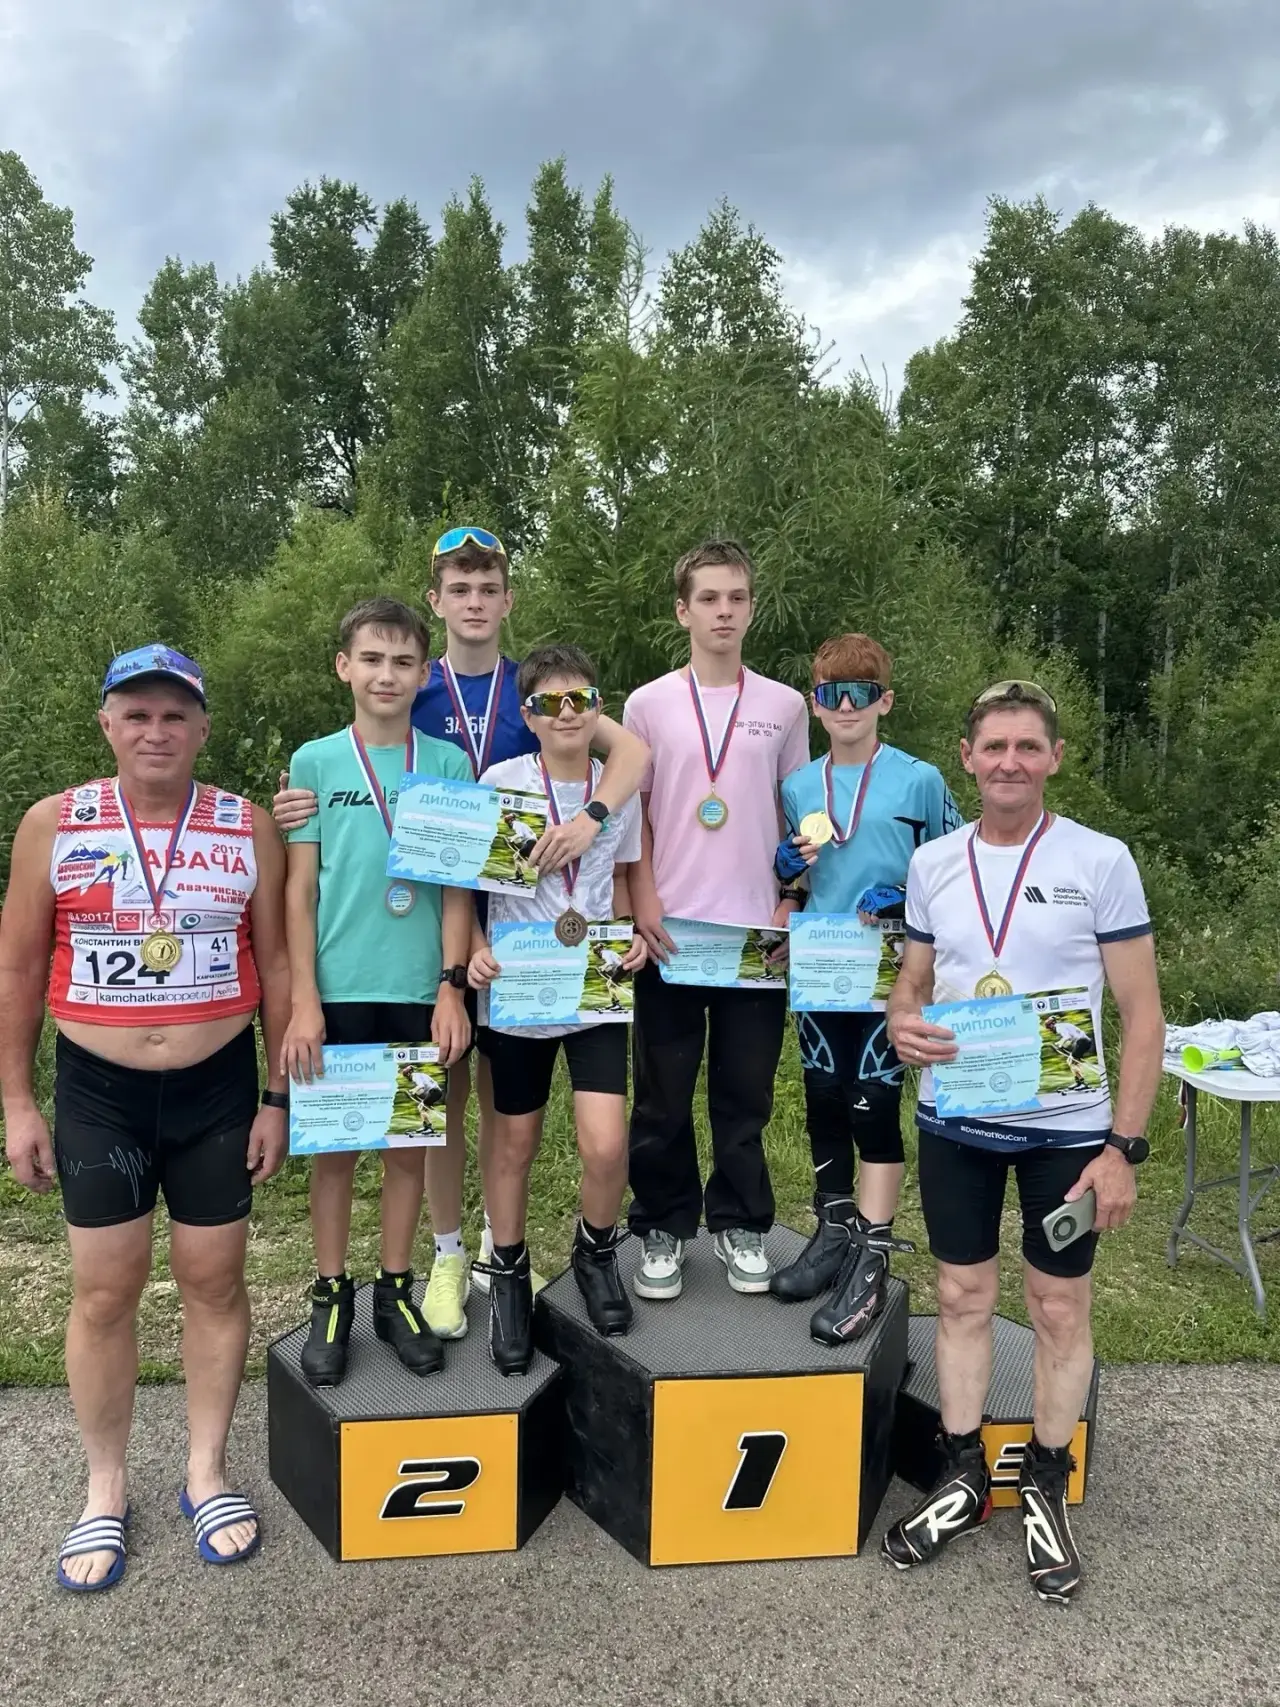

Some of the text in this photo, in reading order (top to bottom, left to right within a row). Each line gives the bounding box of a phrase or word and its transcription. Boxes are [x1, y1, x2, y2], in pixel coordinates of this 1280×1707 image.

[328, 790, 375, 808] FILA
[419, 793, 481, 811] ДИПЛОМ
[212, 844, 242, 855] 2017
[145, 849, 249, 876] АВАЧА
[1053, 886, 1079, 894] Galaxy
[75, 937, 131, 946] КОНСТАНТИН
[808, 929, 864, 940] ДИПЛОМ
[211, 936, 228, 952] 41
[513, 939, 566, 951] ДИПЛО
[86, 951, 170, 985] 124
[100, 991, 210, 1003] kamchatkaloppet.ru
[951, 1014, 1017, 1034] ДИПЛОМ
[323, 1061, 376, 1075] ИПЛОМ
[960, 1125, 1028, 1142] #DoWhatYouCant
[721, 1430, 789, 1512] 1
[379, 1456, 482, 1520] 2
